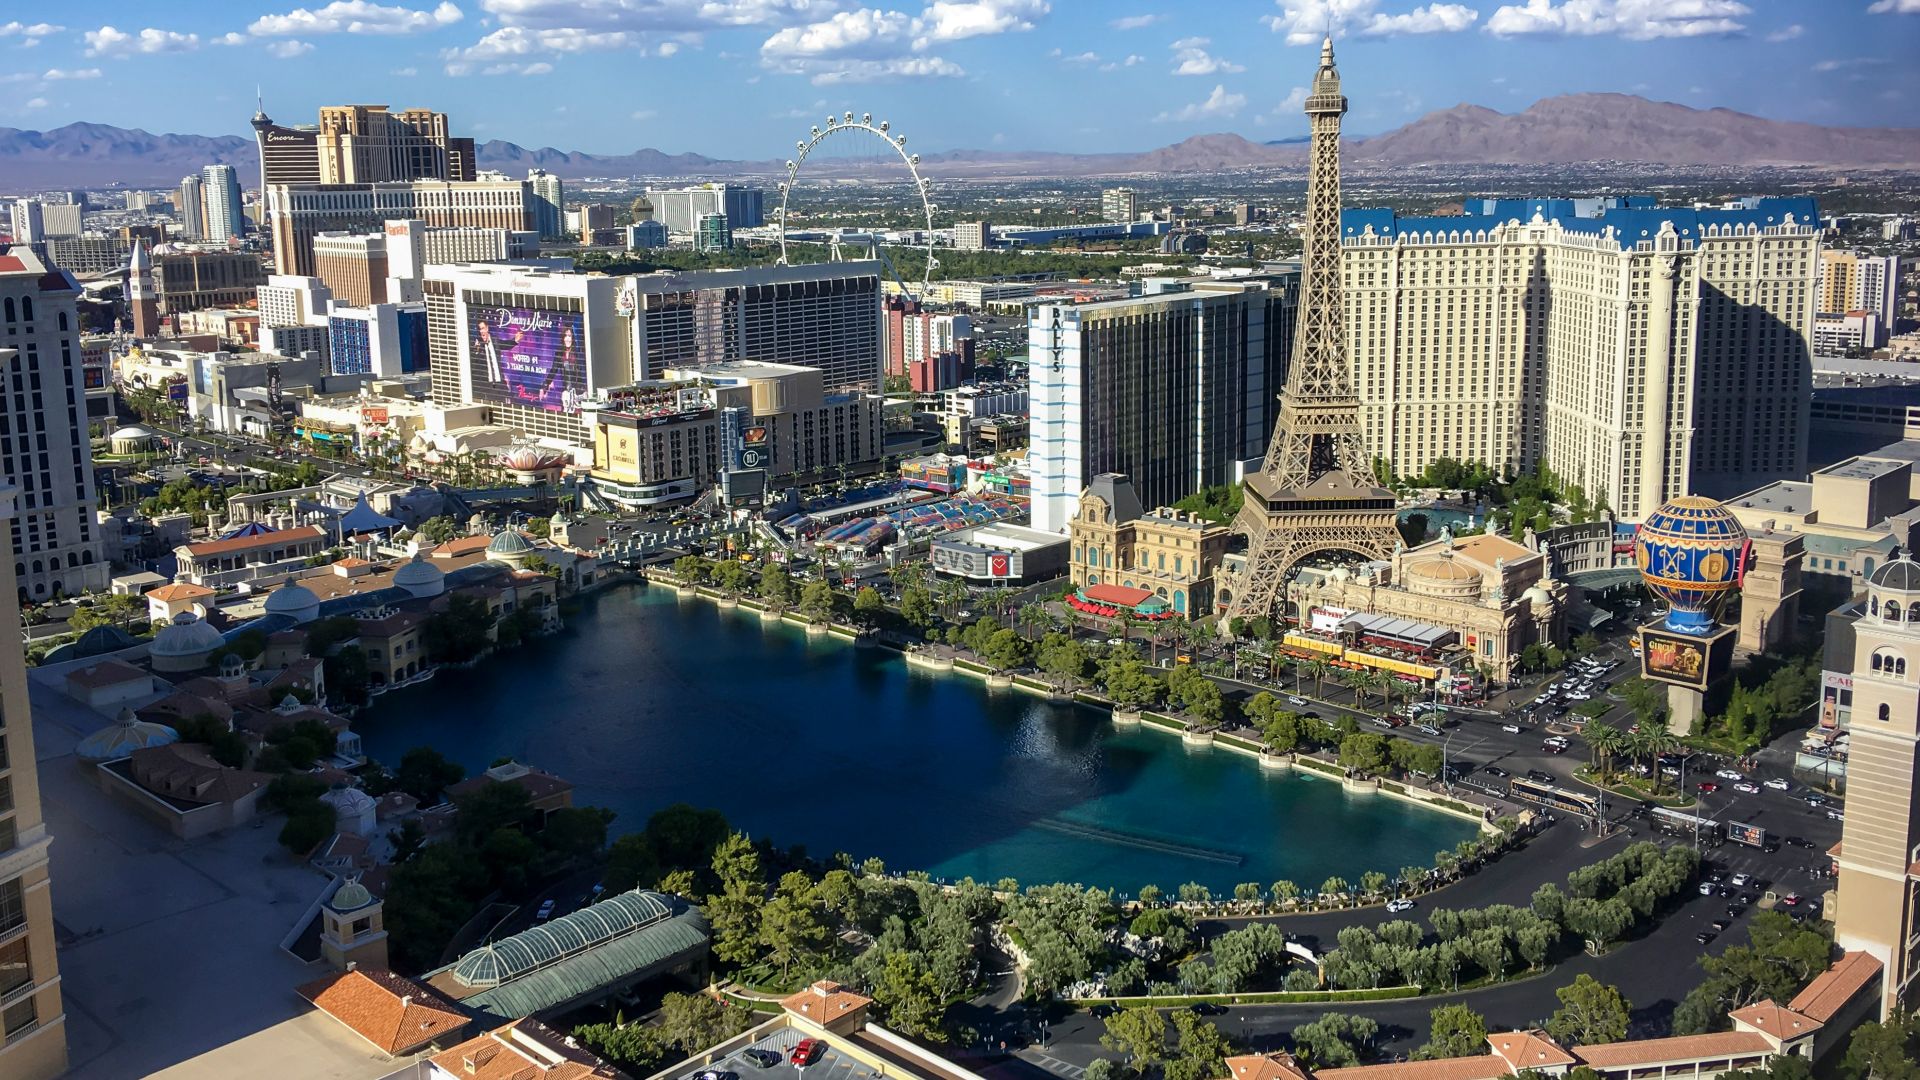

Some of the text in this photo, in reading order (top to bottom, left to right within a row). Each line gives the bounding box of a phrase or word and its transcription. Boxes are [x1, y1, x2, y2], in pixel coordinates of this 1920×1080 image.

[267, 131, 304, 142] Encore
[512, 353, 530, 363] VOTED
[934, 548, 974, 572] CVS
[1649, 640, 1676, 653] CIRCUS
